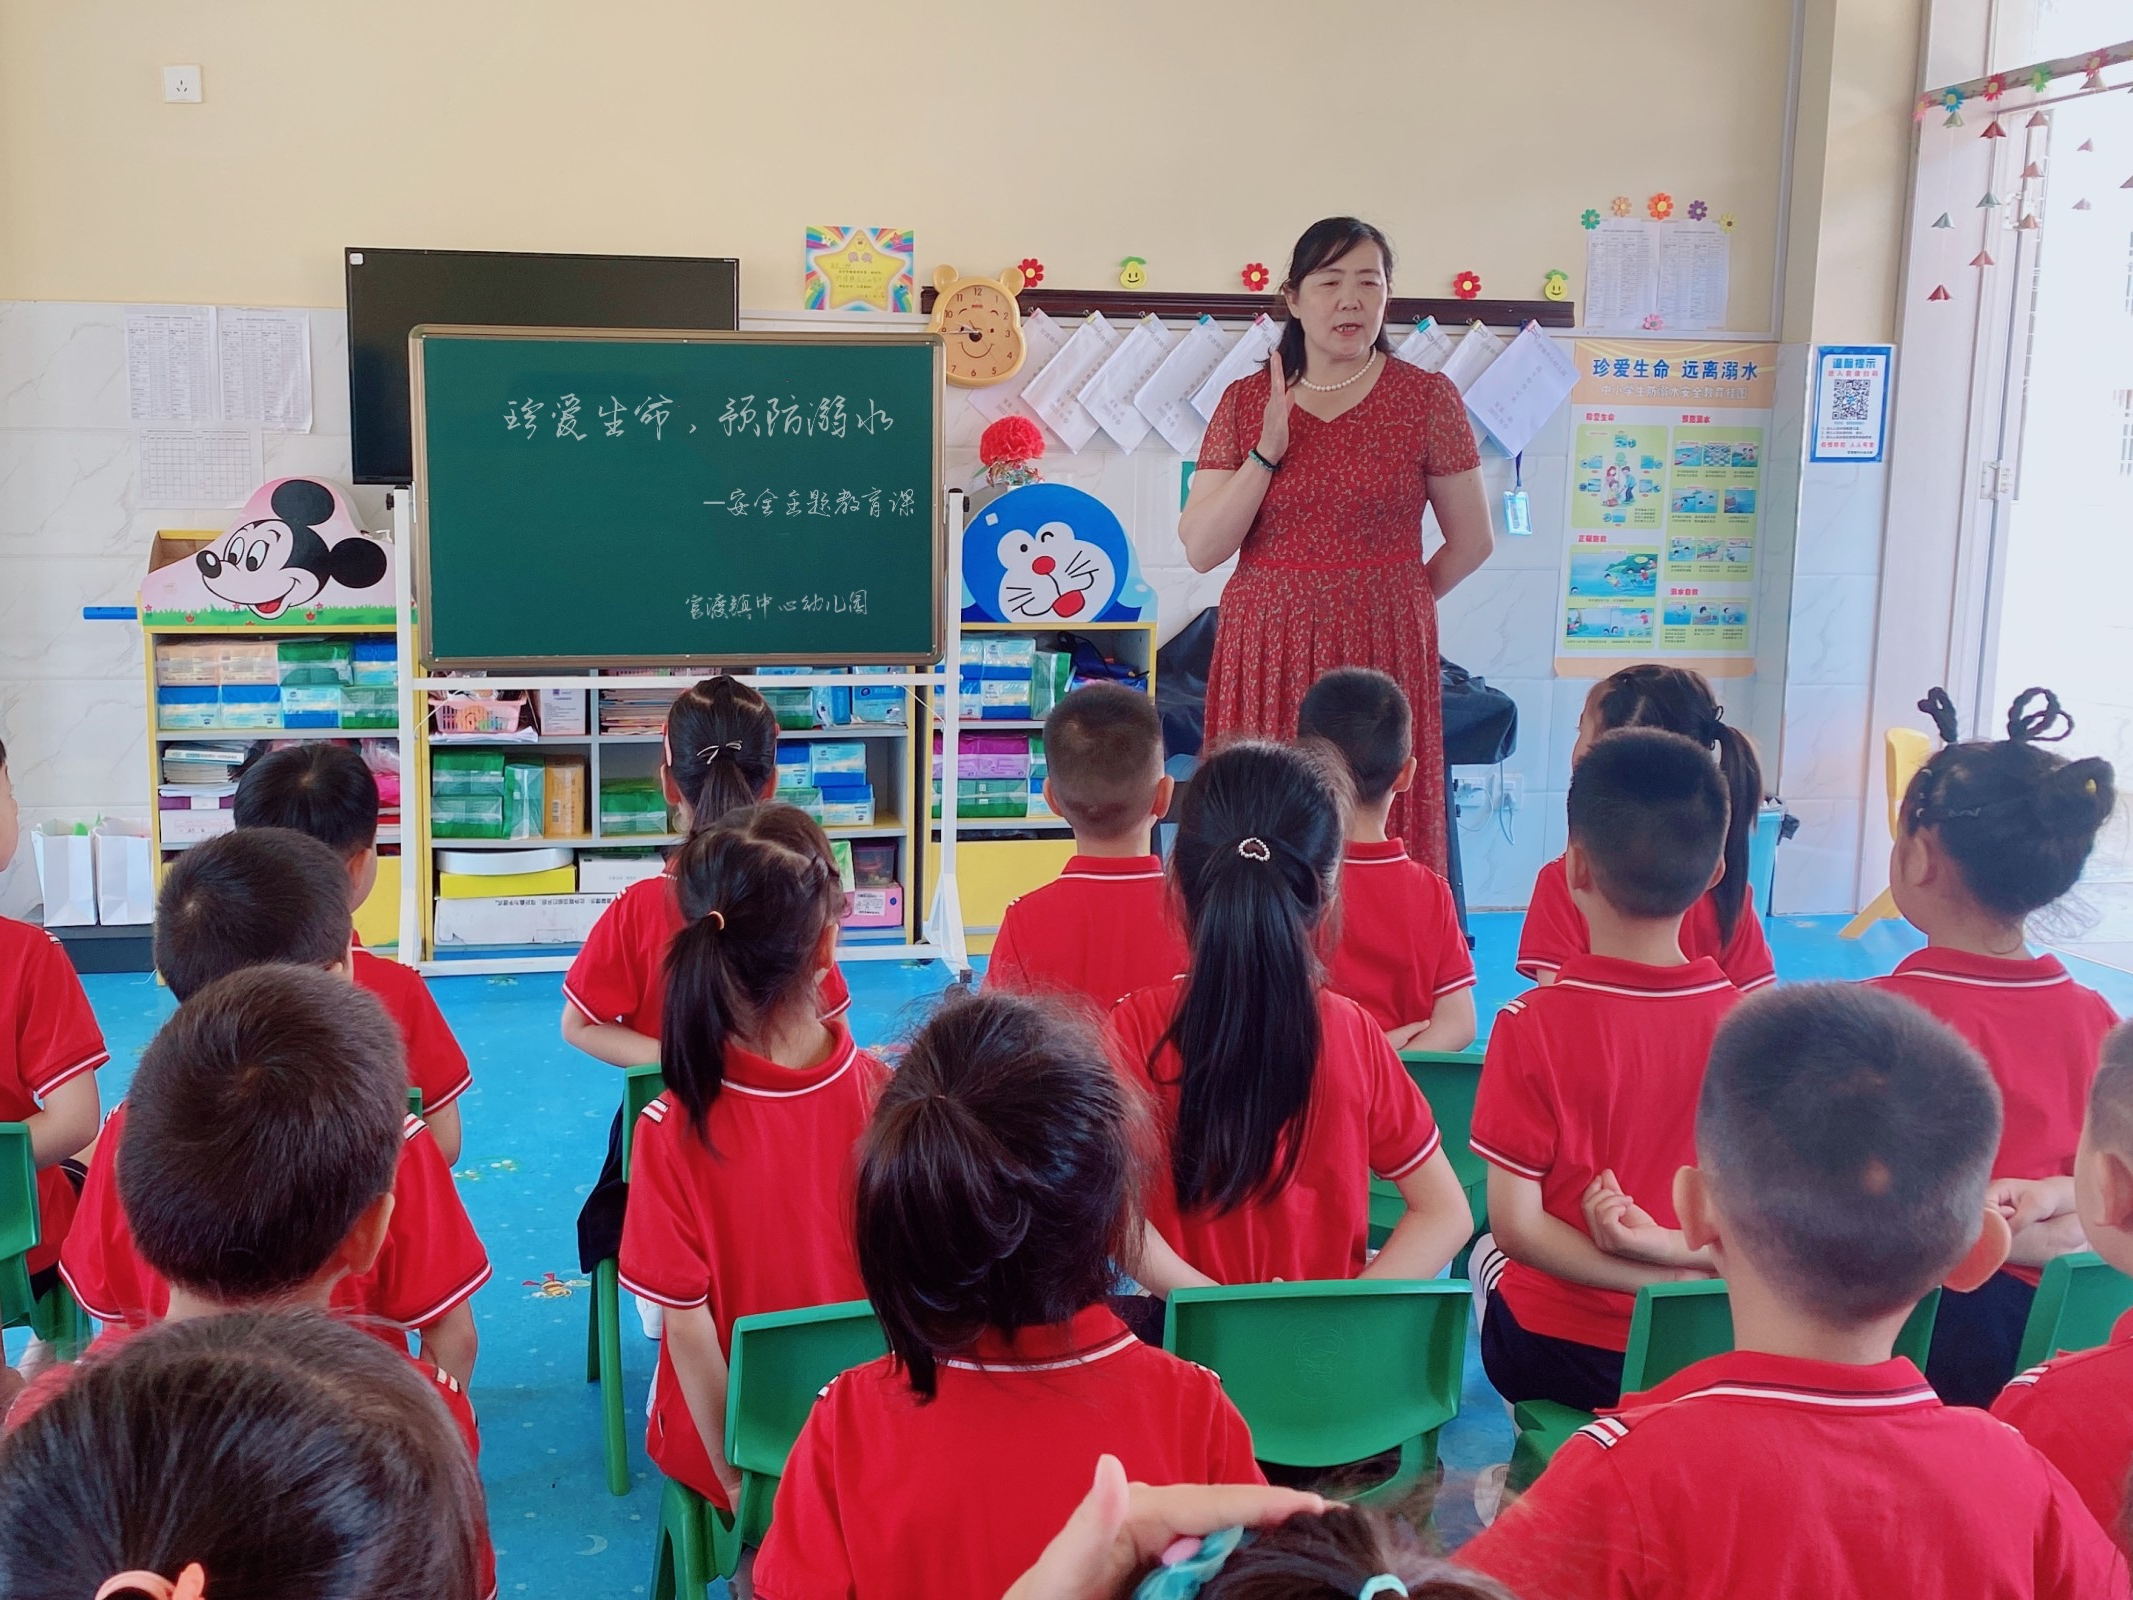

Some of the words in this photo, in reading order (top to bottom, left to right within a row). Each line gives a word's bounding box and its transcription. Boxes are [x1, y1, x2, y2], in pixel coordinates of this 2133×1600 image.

[974, 288, 982, 296] 12
[956, 294, 963, 302] 11
[945, 310, 953, 318] 10
[1003, 312, 1009, 320] 2
[1005, 330, 1010, 338] 3
[1007, 351, 1012, 359] 4
[951, 365, 956, 373] 7
[971, 369, 976, 377] 6
[992, 367, 996, 375] 5
[1592, 358, 1670, 379] 珍爱生命
[1681, 360, 1758, 381] 远离溺水
[685, 589, 868, 620] 官渡镇中心幼儿园
